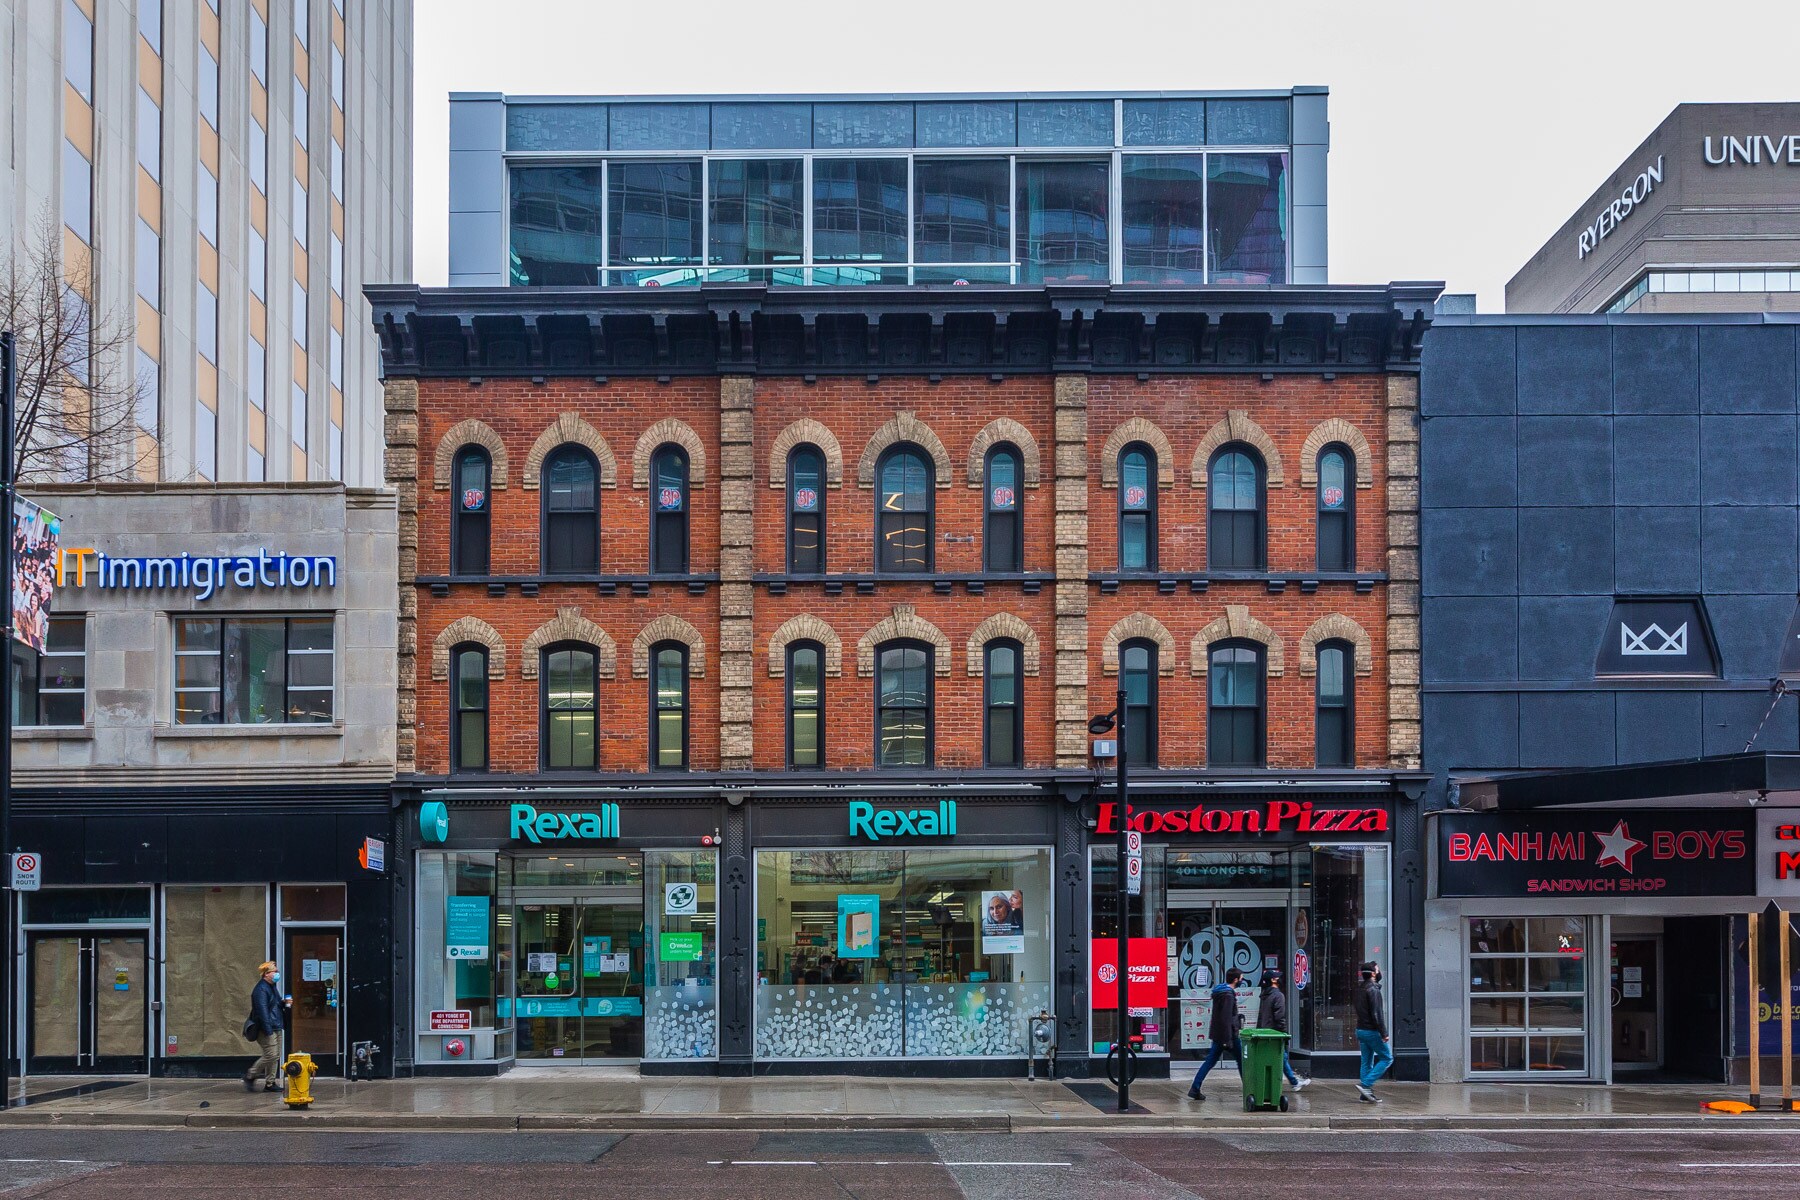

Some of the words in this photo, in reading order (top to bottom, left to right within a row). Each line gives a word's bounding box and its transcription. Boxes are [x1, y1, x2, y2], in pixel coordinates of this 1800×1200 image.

[1703, 135, 1800, 165] UNIVE
[1578, 155, 1665, 260] RYERSON
[98, 547, 336, 601] immigration
[510, 803, 620, 843] Rexall
[849, 800, 957, 841] Rexall
[1264, 800, 1389, 832] Pizza
[1448, 832, 1543, 861] BANH
[1548, 831, 1585, 861] MI
[1652, 830, 1746, 860] BOYS
[1176, 866, 1198, 875] 401
[1201, 866, 1245, 875] YONGE
[1527, 879, 1616, 892] SANDWICH
[1619, 878, 1667, 891] SHOP
[460, 948, 481, 956] Rexall
[1127, 965, 1160, 973] oston
